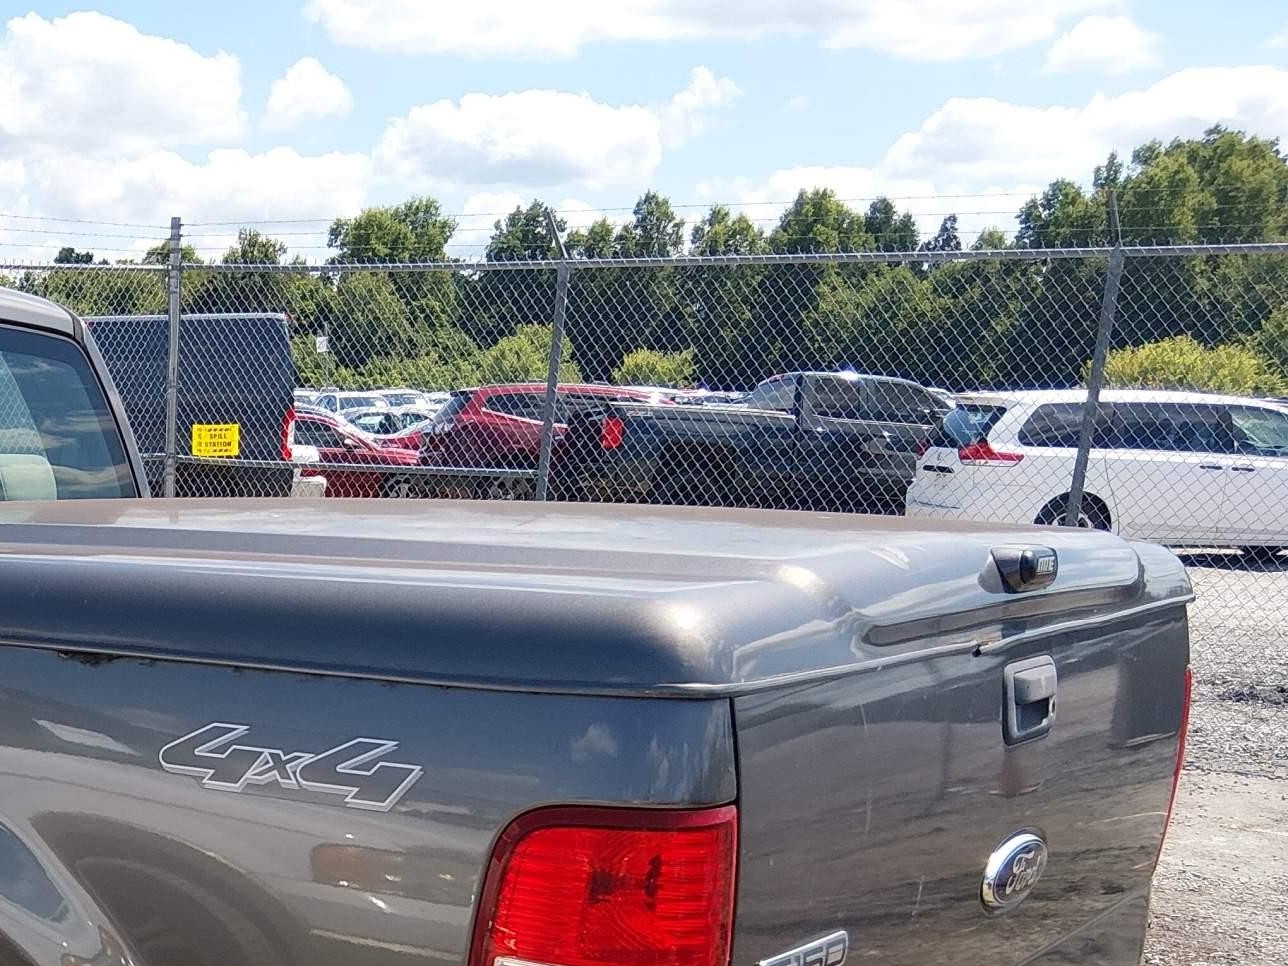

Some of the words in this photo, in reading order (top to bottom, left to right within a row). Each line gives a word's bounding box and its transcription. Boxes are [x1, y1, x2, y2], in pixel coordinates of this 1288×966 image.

[204, 440, 232, 448] STATION
[159, 722, 424, 812] 4x4
[1005, 849, 1042, 895] Ford
